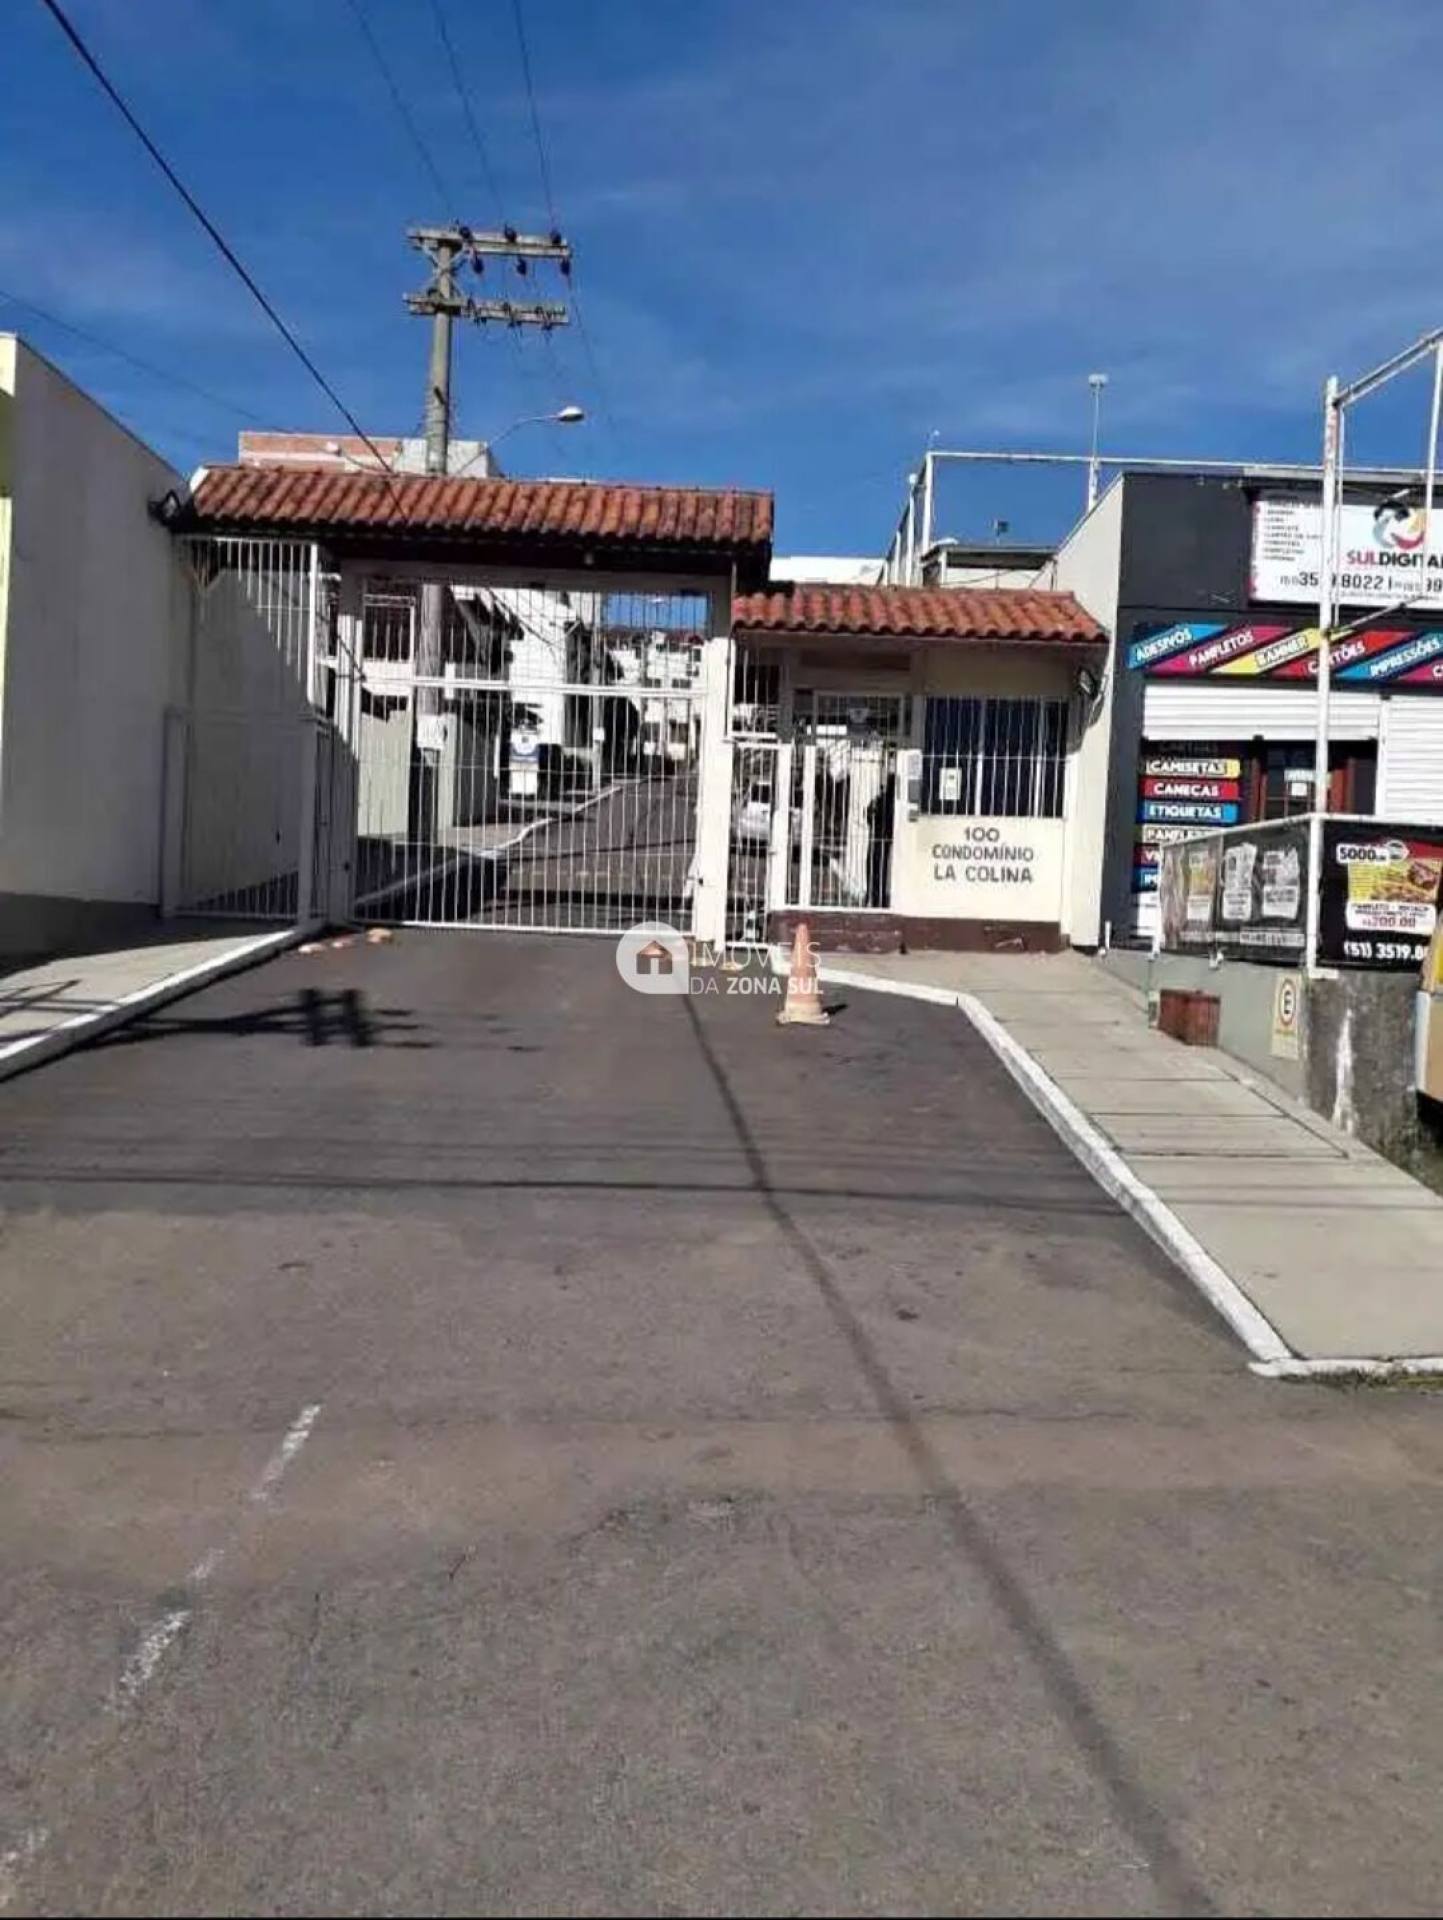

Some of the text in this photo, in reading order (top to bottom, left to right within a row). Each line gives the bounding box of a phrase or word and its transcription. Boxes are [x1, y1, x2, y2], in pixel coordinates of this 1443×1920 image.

[1136, 627, 1192, 661] ADESIVOS
[1255, 636, 1309, 667] BANNER
[1370, 637, 1441, 677] IMPRESSÕES
[1150, 759, 1226, 774] CAMISETAS
[1153, 782, 1220, 798] CANECAS
[1149, 804, 1222, 819] ETIQUETAS
[964, 827, 1001, 843] 100
[932, 841, 1034, 862] CONDOMÍNIO
[1339, 847, 1377, 862] 5000
[934, 863, 1033, 883] LA COLINA
[1343, 941, 1372, 958] (51)
